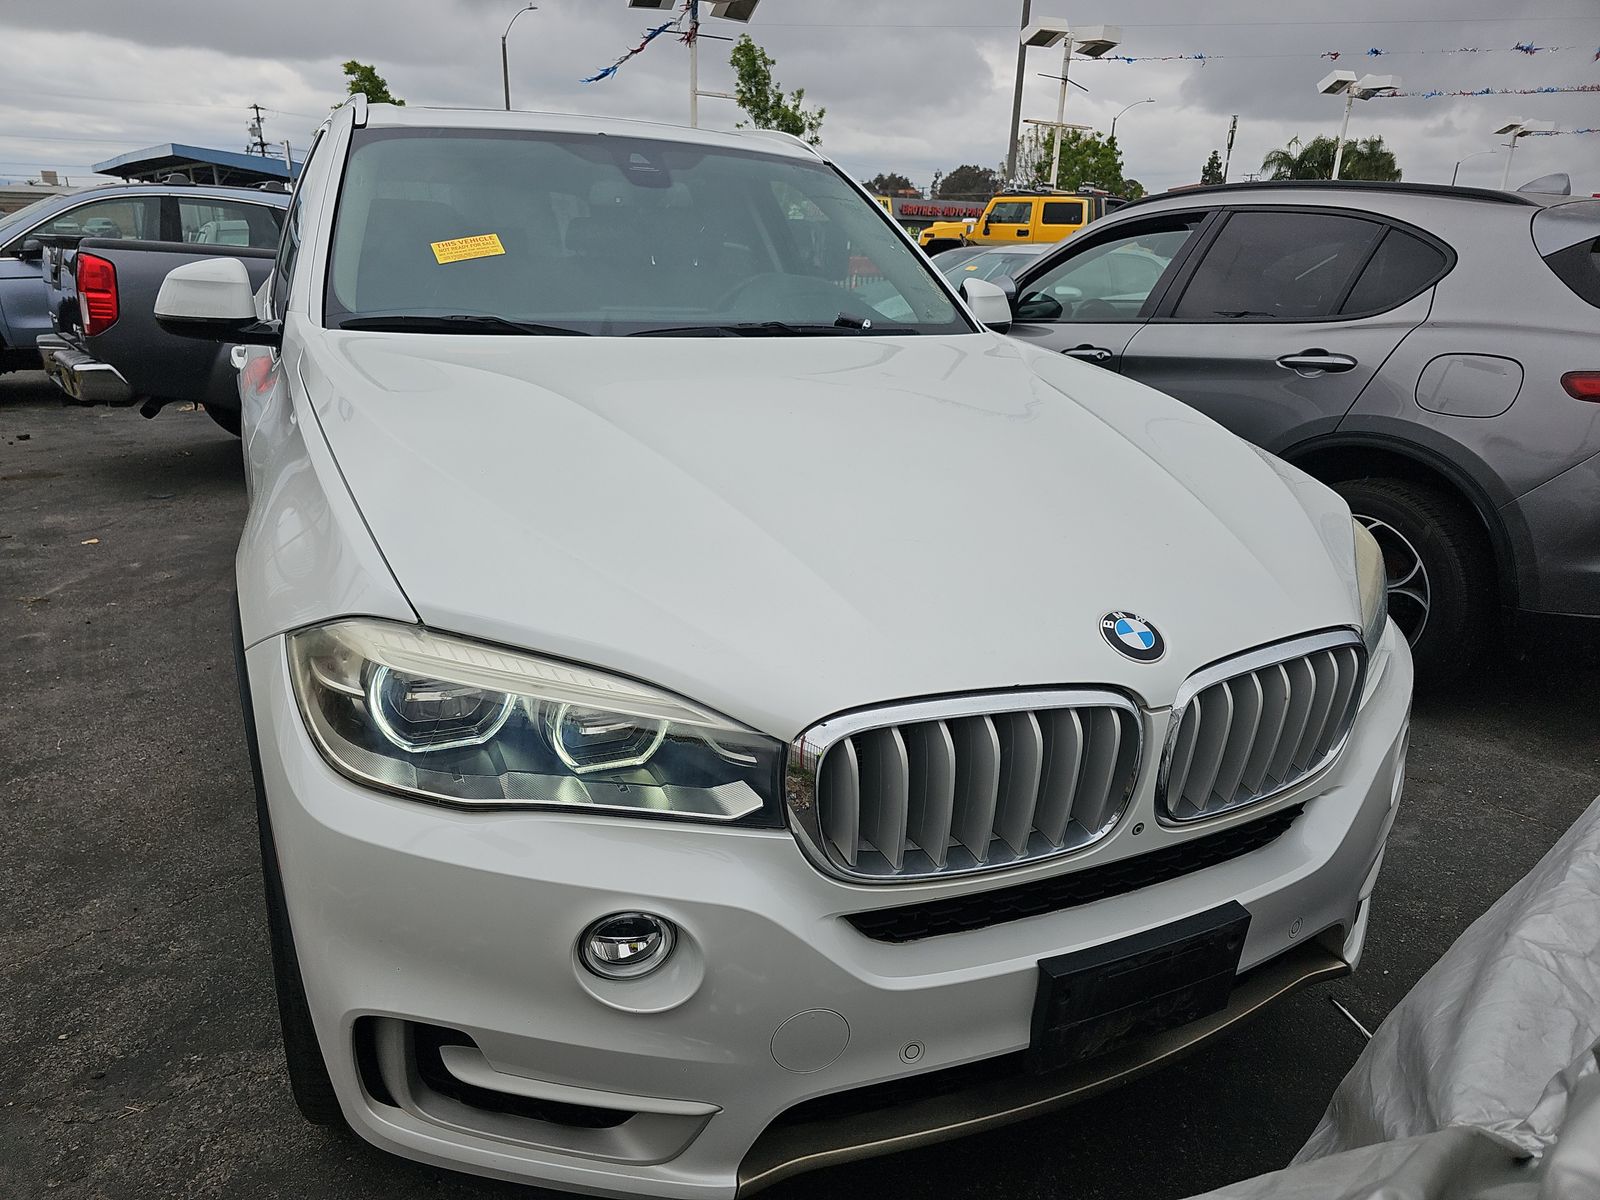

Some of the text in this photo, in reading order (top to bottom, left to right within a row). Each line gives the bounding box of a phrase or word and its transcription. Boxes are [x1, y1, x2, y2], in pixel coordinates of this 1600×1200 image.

[901, 204, 984, 217] BROTHERS AUTO PAR
[436, 236, 495, 249] THIS VEHICLE
[1103, 611, 1146, 629] BMW
